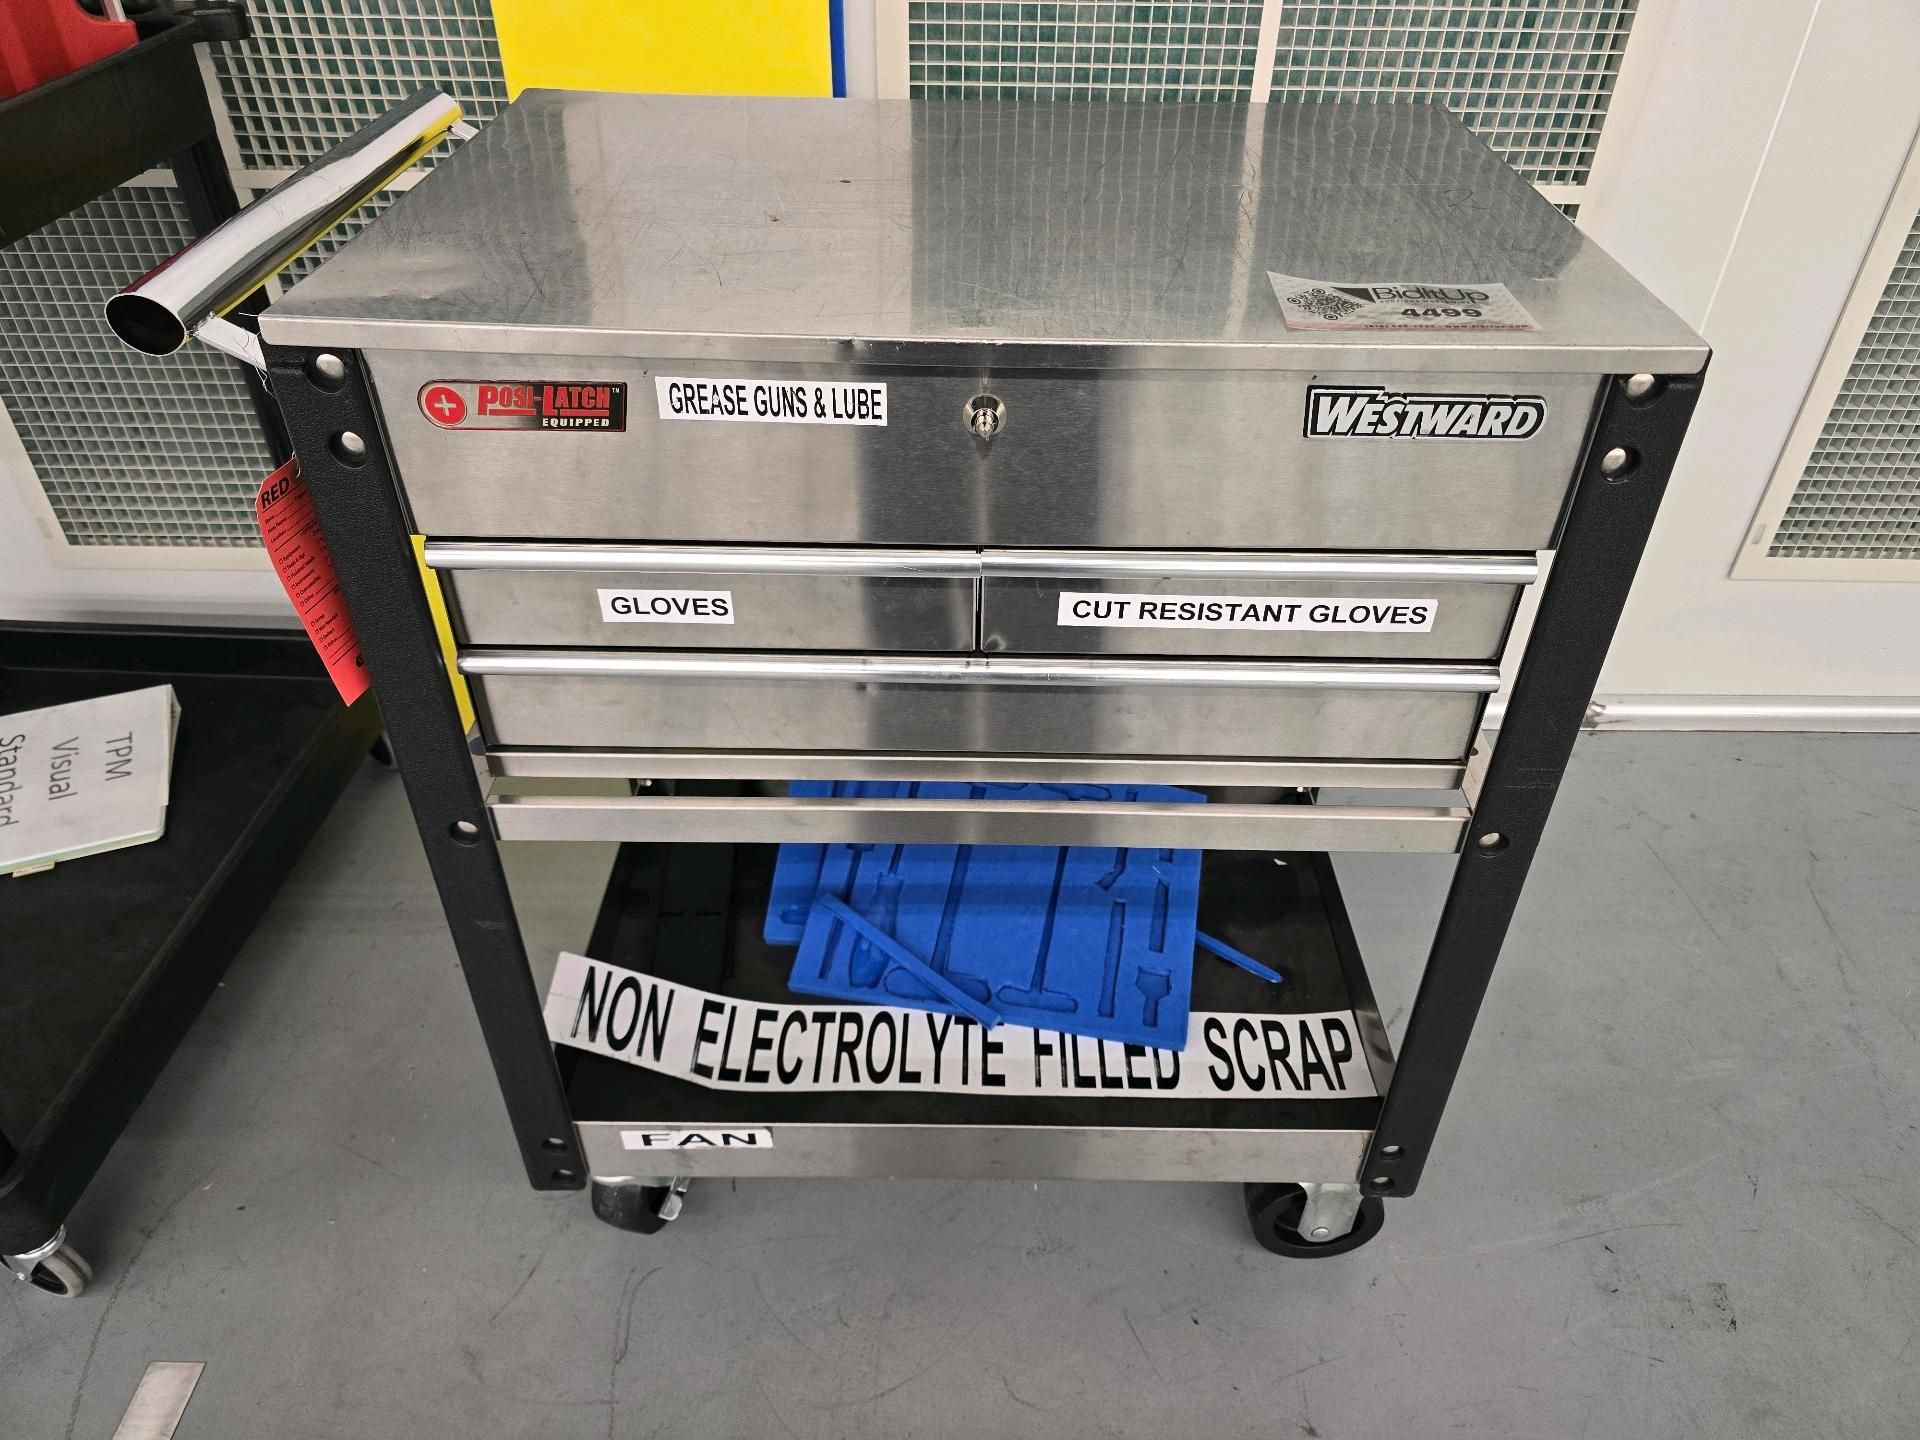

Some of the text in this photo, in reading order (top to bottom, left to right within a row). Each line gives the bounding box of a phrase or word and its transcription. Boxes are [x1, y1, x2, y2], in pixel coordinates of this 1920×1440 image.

[1371, 287, 1490, 304] BidItUp
[1401, 308, 1483, 317] 4499
[477, 385, 610, 416] POSI-LATCH
[669, 382, 882, 420] GREASE GUNS & LUBE
[1316, 396, 1538, 436] WESTWARD
[542, 418, 610, 427] EQUIPPED
[261, 477, 289, 510] RED
[611, 596, 729, 617] GLOVES
[1072, 600, 1428, 625] CUT RESISTANT GLOVES
[49, 736, 80, 801] Visual
[105, 730, 133, 782] TPM
[0, 734, 26, 827] Standard
[571, 966, 675, 1062] NON
[690, 998, 1006, 1087] ELECTROLYTE
[1203, 1016, 1353, 1091] SCRAP
[641, 1132, 758, 1147] FAN
